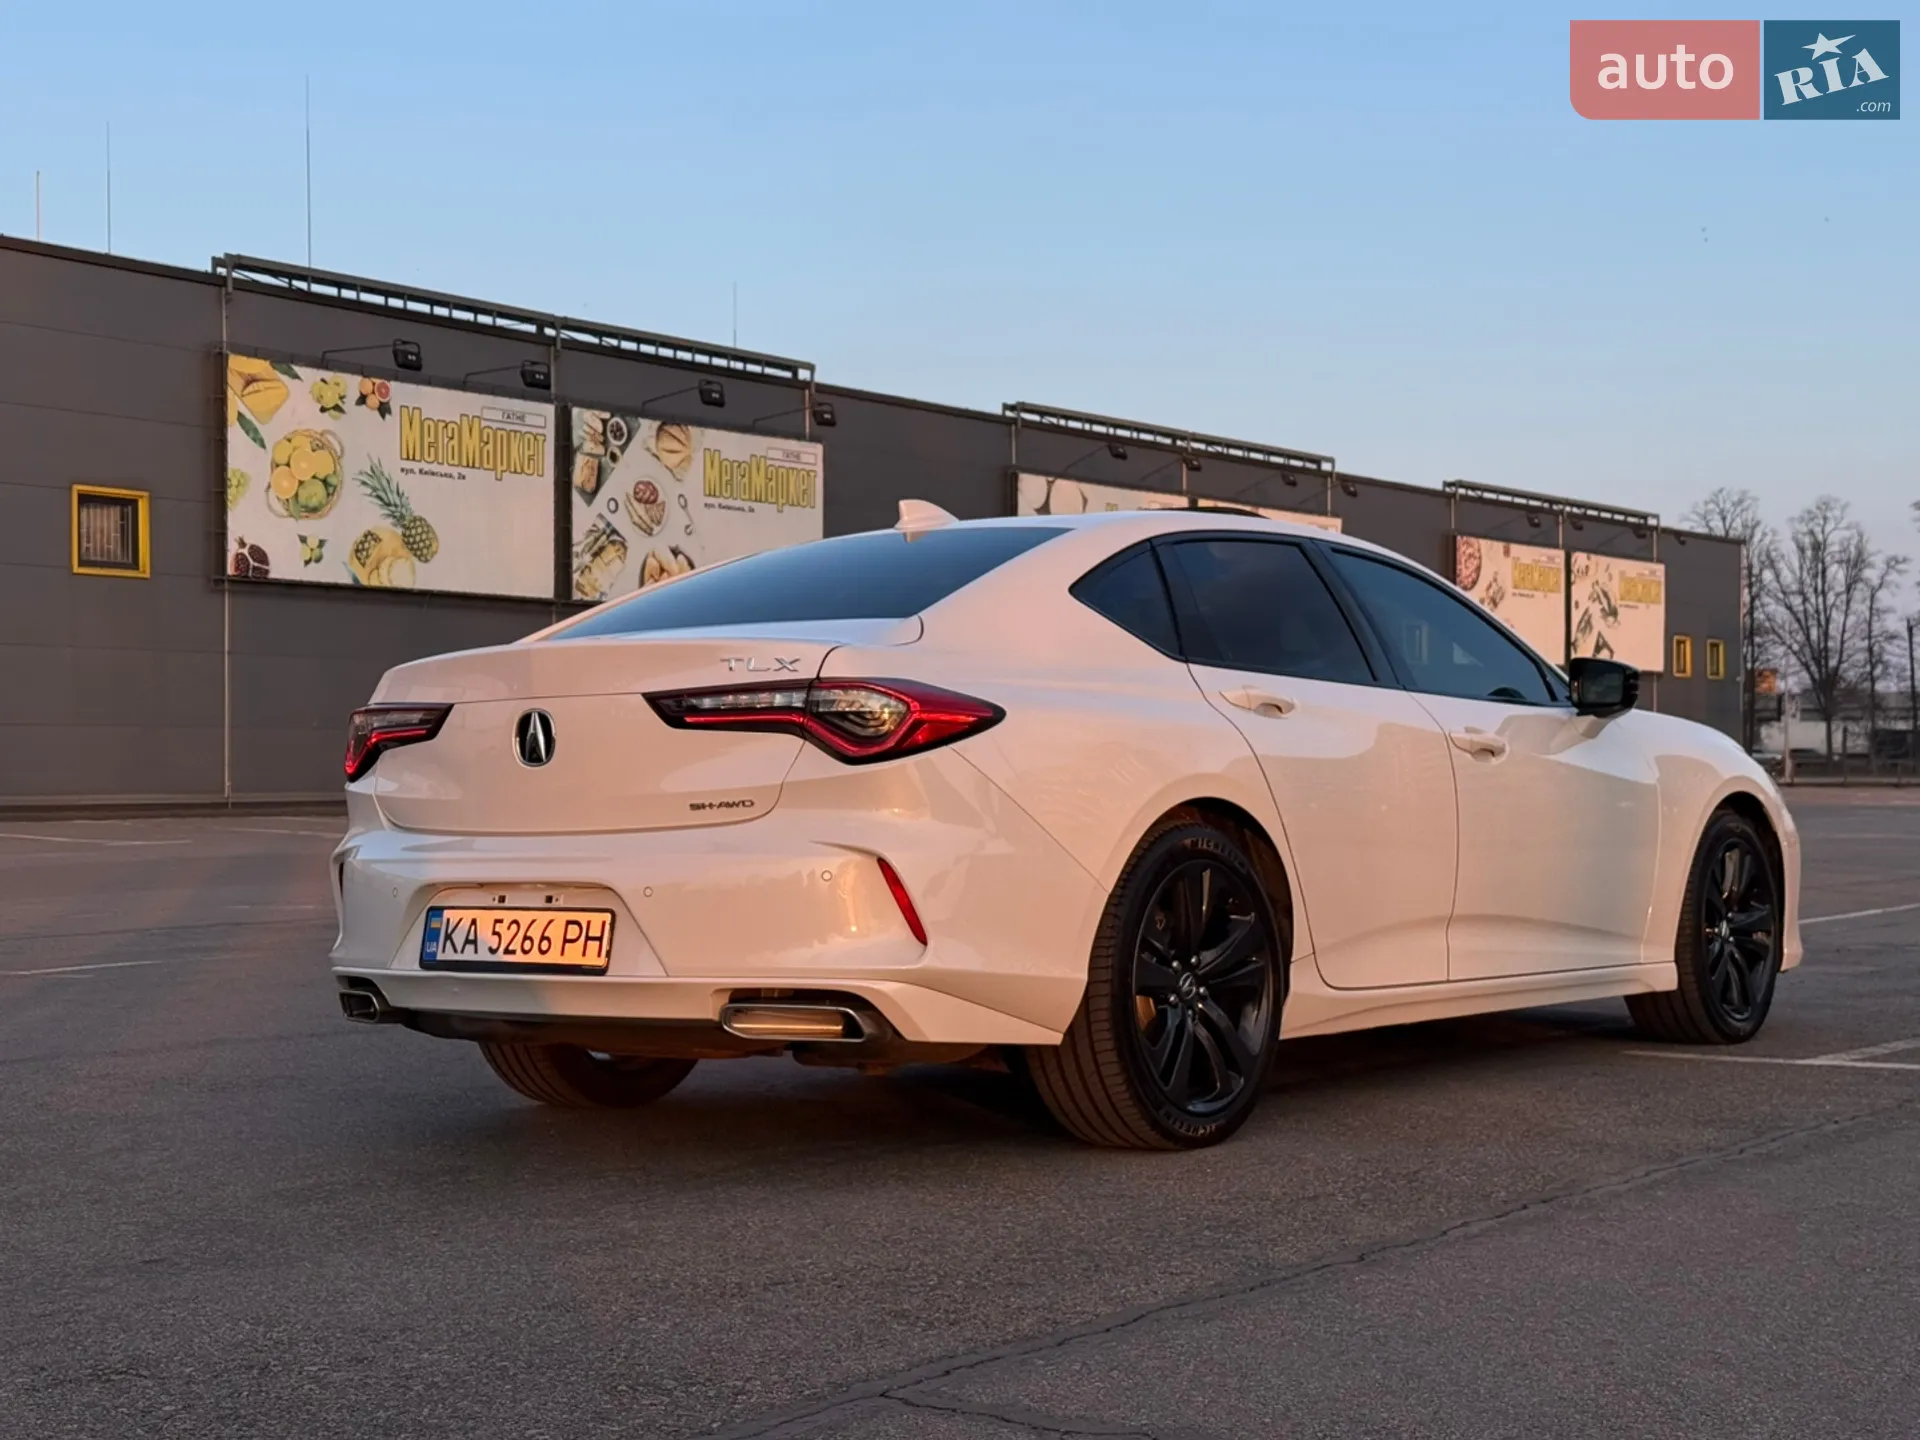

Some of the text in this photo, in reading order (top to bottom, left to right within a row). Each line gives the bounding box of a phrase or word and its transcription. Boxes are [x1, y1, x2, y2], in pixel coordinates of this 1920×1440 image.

[400, 404, 547, 481] МегаМаркет
[703, 447, 818, 513] МегаМаркет
[719, 657, 802, 673] TLX
[426, 942, 438, 953] UA
[441, 917, 607, 958] KA 5266 PH
